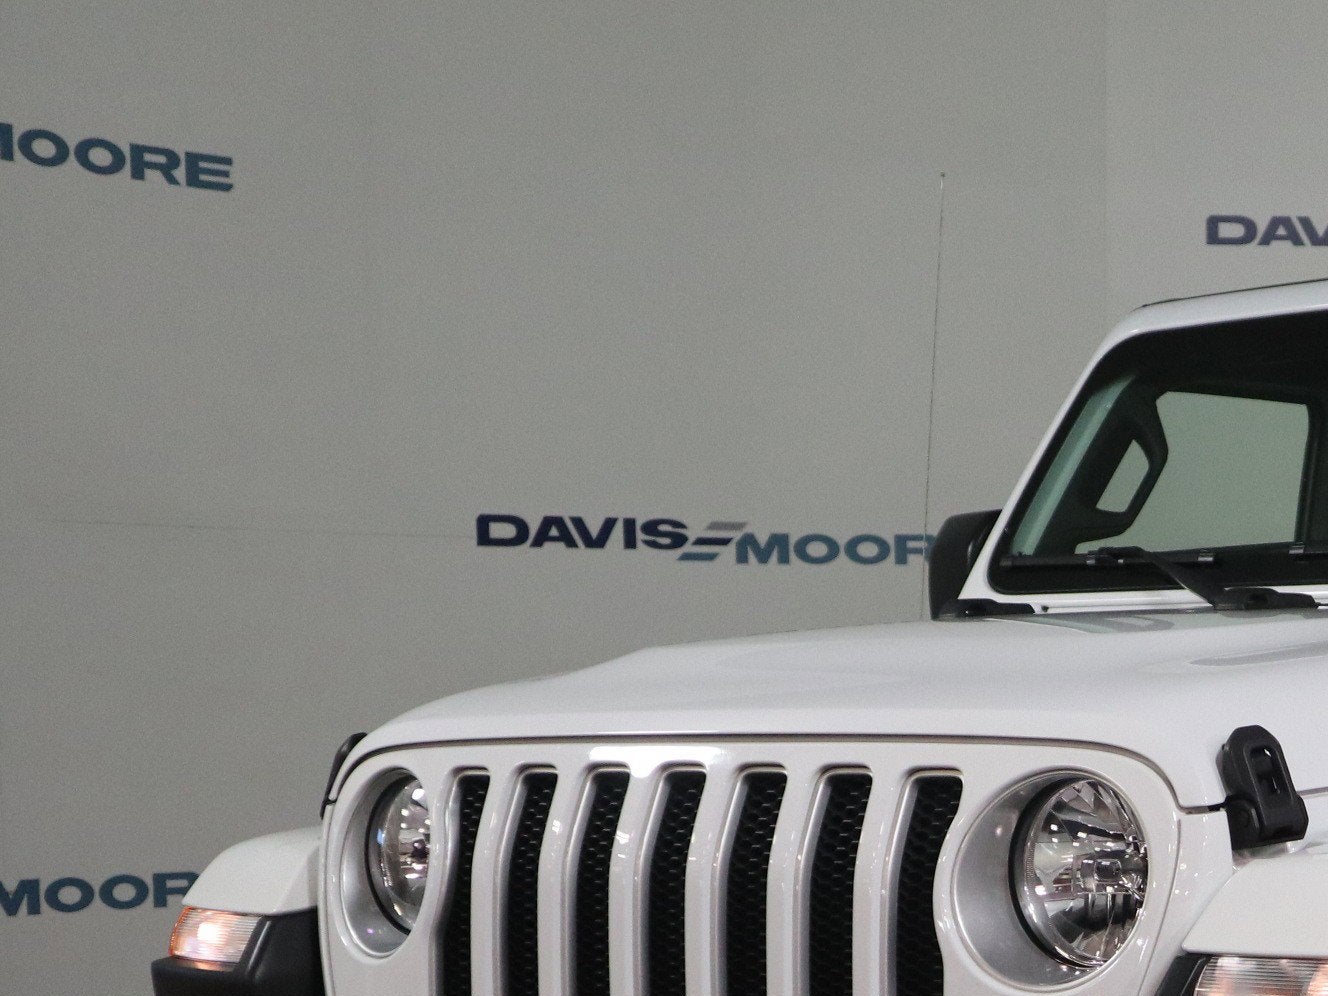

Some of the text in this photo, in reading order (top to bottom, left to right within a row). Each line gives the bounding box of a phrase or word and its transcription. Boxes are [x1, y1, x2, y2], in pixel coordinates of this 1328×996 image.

[0, 122, 234, 192] OORE
[475, 513, 935, 566] DAVIS MOOR
[0, 871, 200, 916] MOOR
